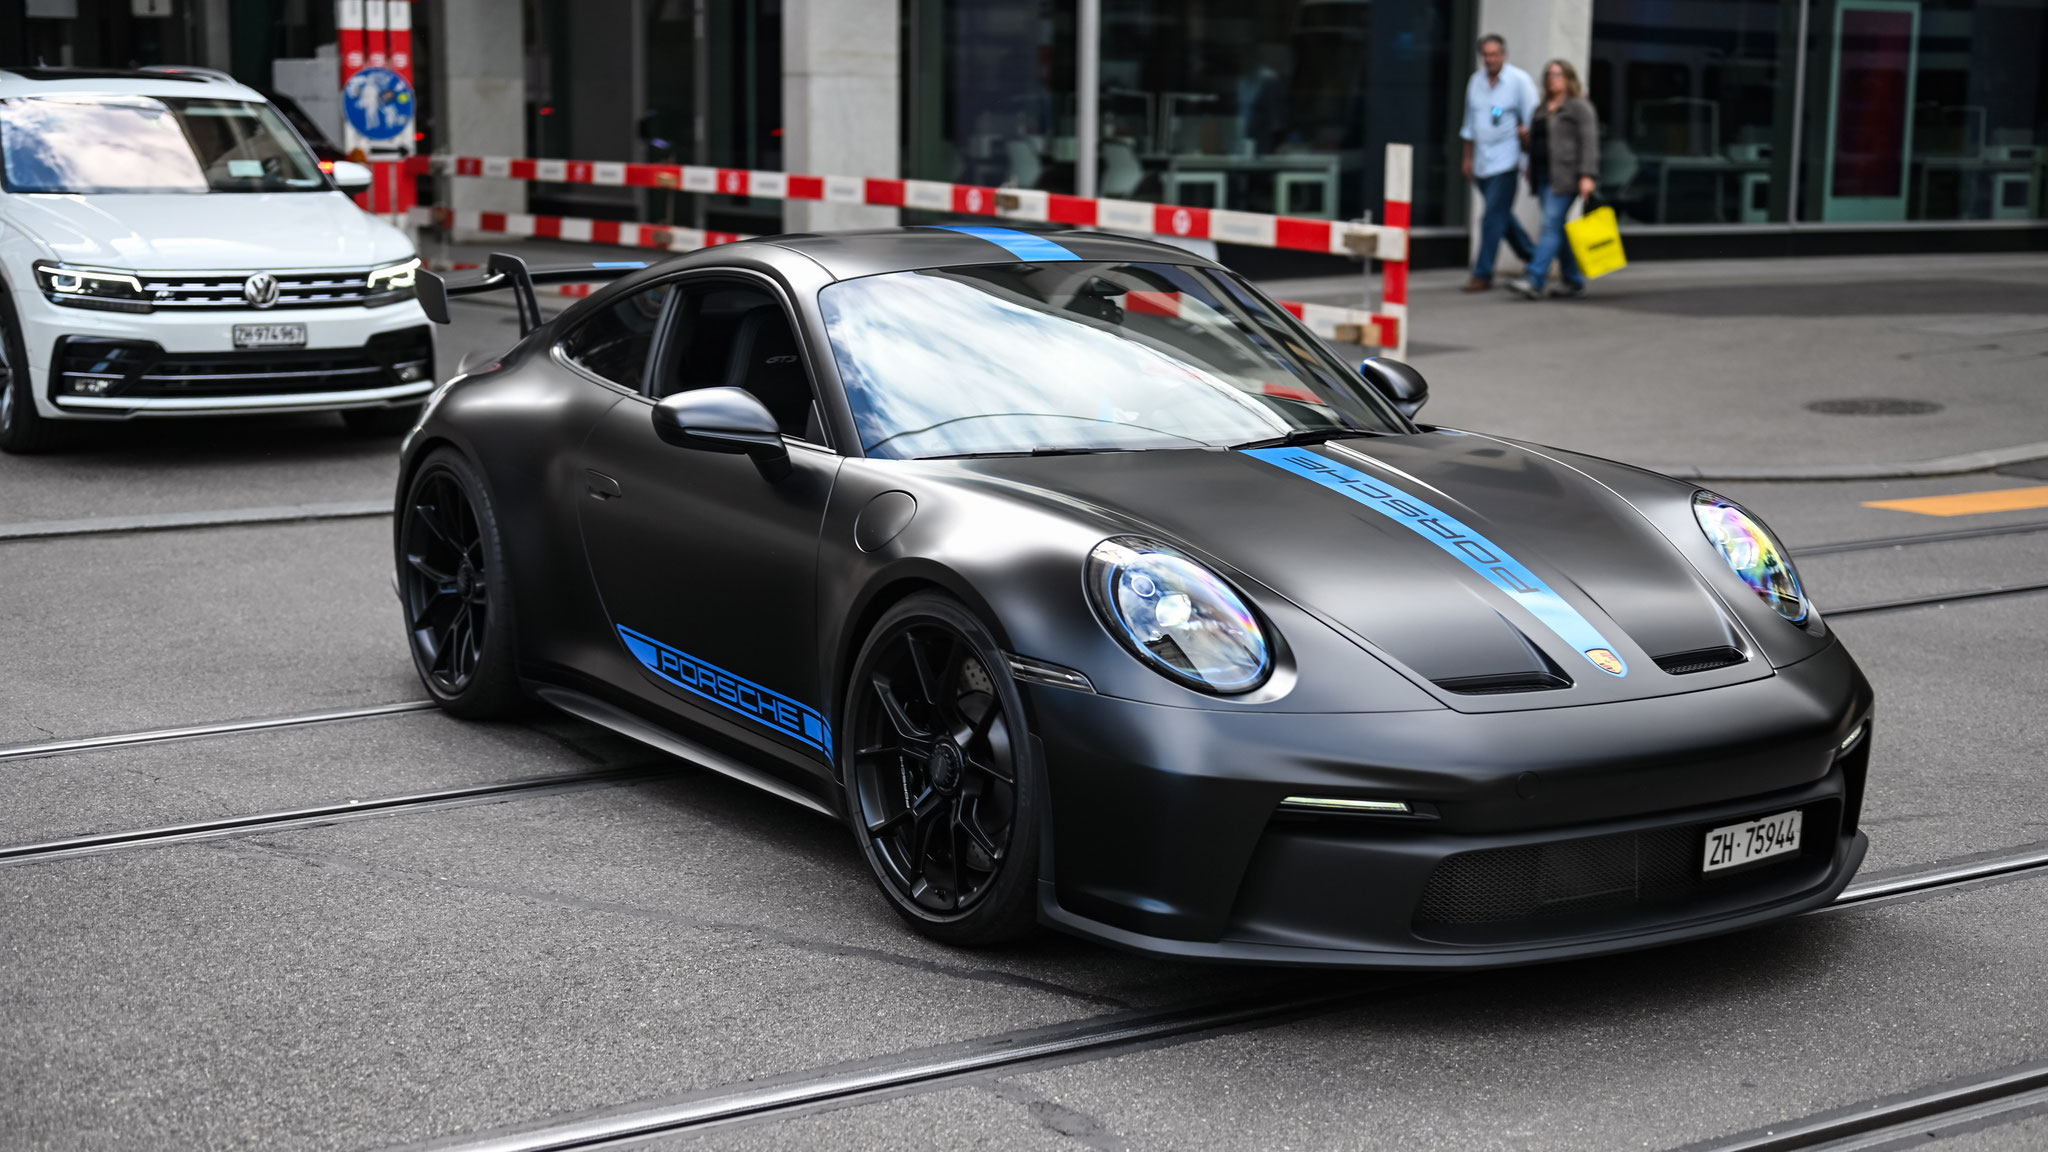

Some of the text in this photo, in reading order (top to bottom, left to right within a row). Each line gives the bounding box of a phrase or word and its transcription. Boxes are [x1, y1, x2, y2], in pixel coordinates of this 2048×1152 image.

[765, 354, 798, 364] GT3
[1283, 455, 1541, 594] PORSCHE
[661, 650, 801, 731] PORSCHE
